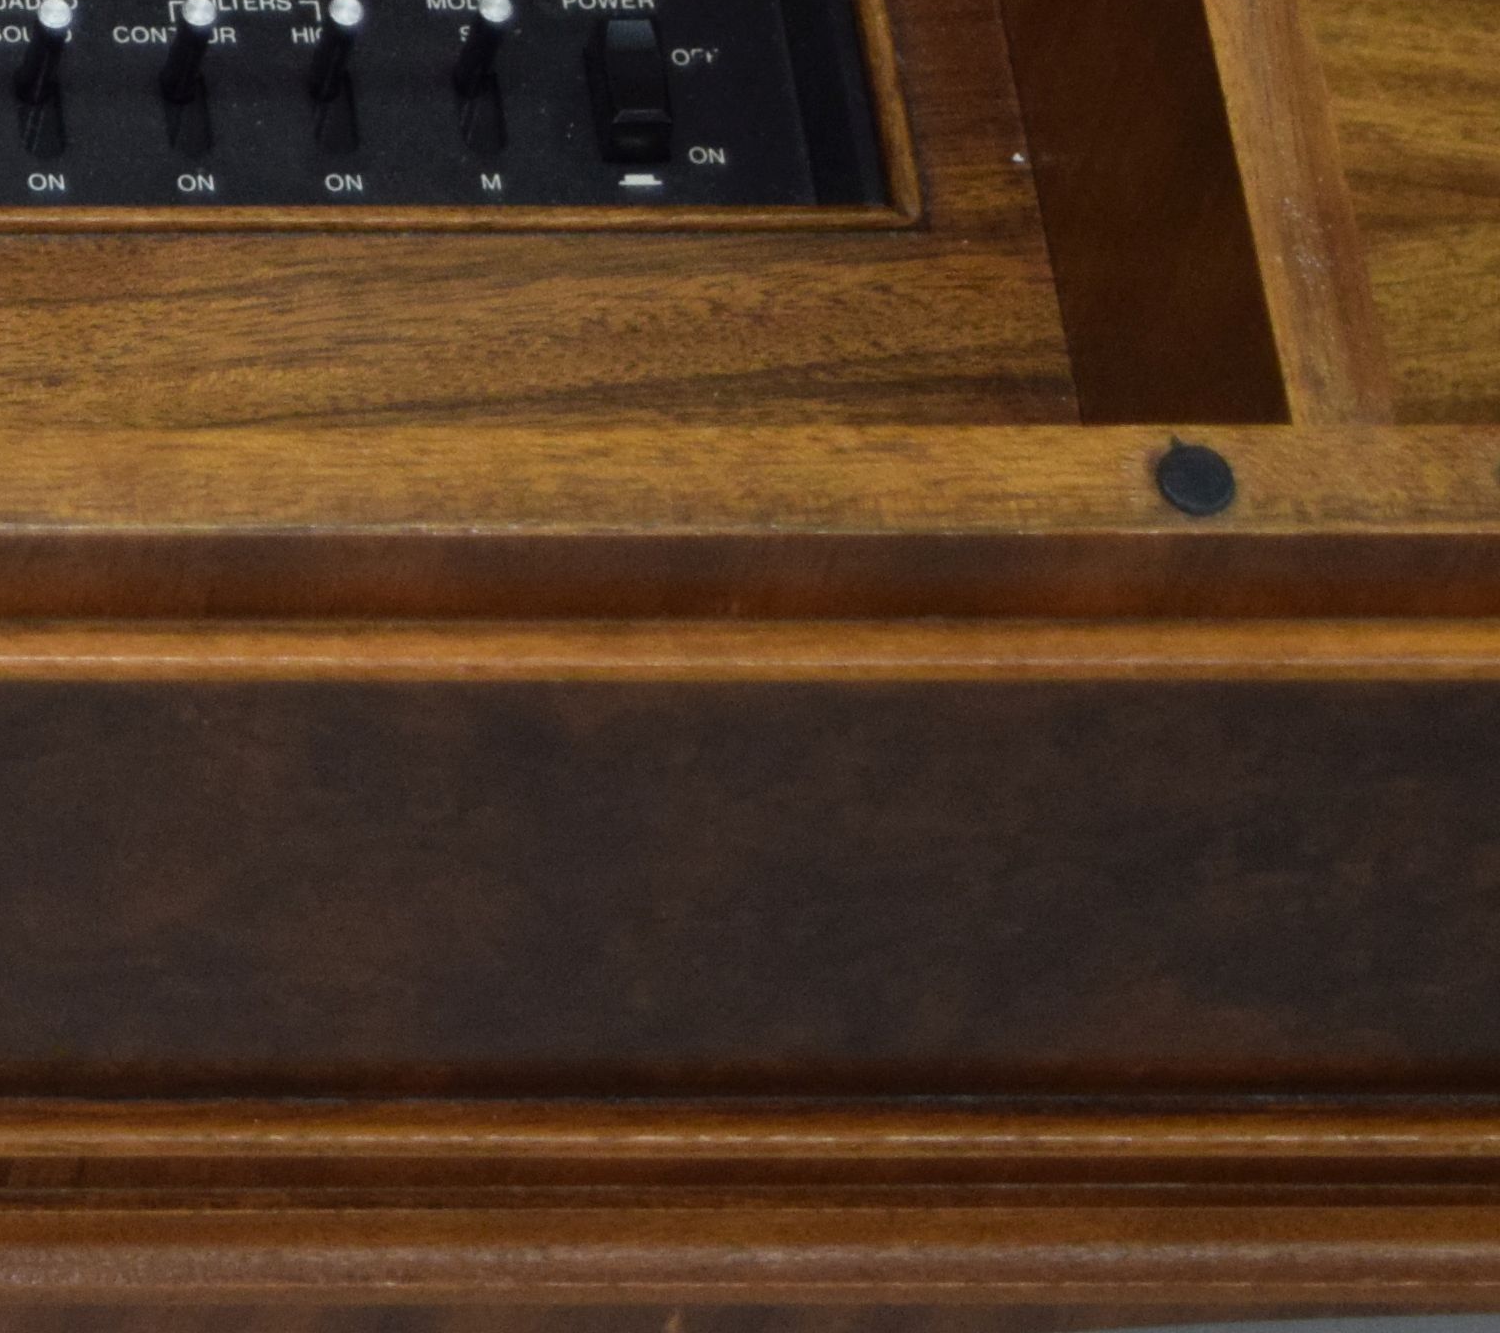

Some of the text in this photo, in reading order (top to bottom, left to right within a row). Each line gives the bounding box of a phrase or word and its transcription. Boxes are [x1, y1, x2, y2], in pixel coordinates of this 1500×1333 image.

[689, 147, 726, 164] ON
[28, 173, 65, 191] ON
[178, 174, 215, 192] ON
[325, 174, 363, 192] ON
[481, 174, 502, 190] M
